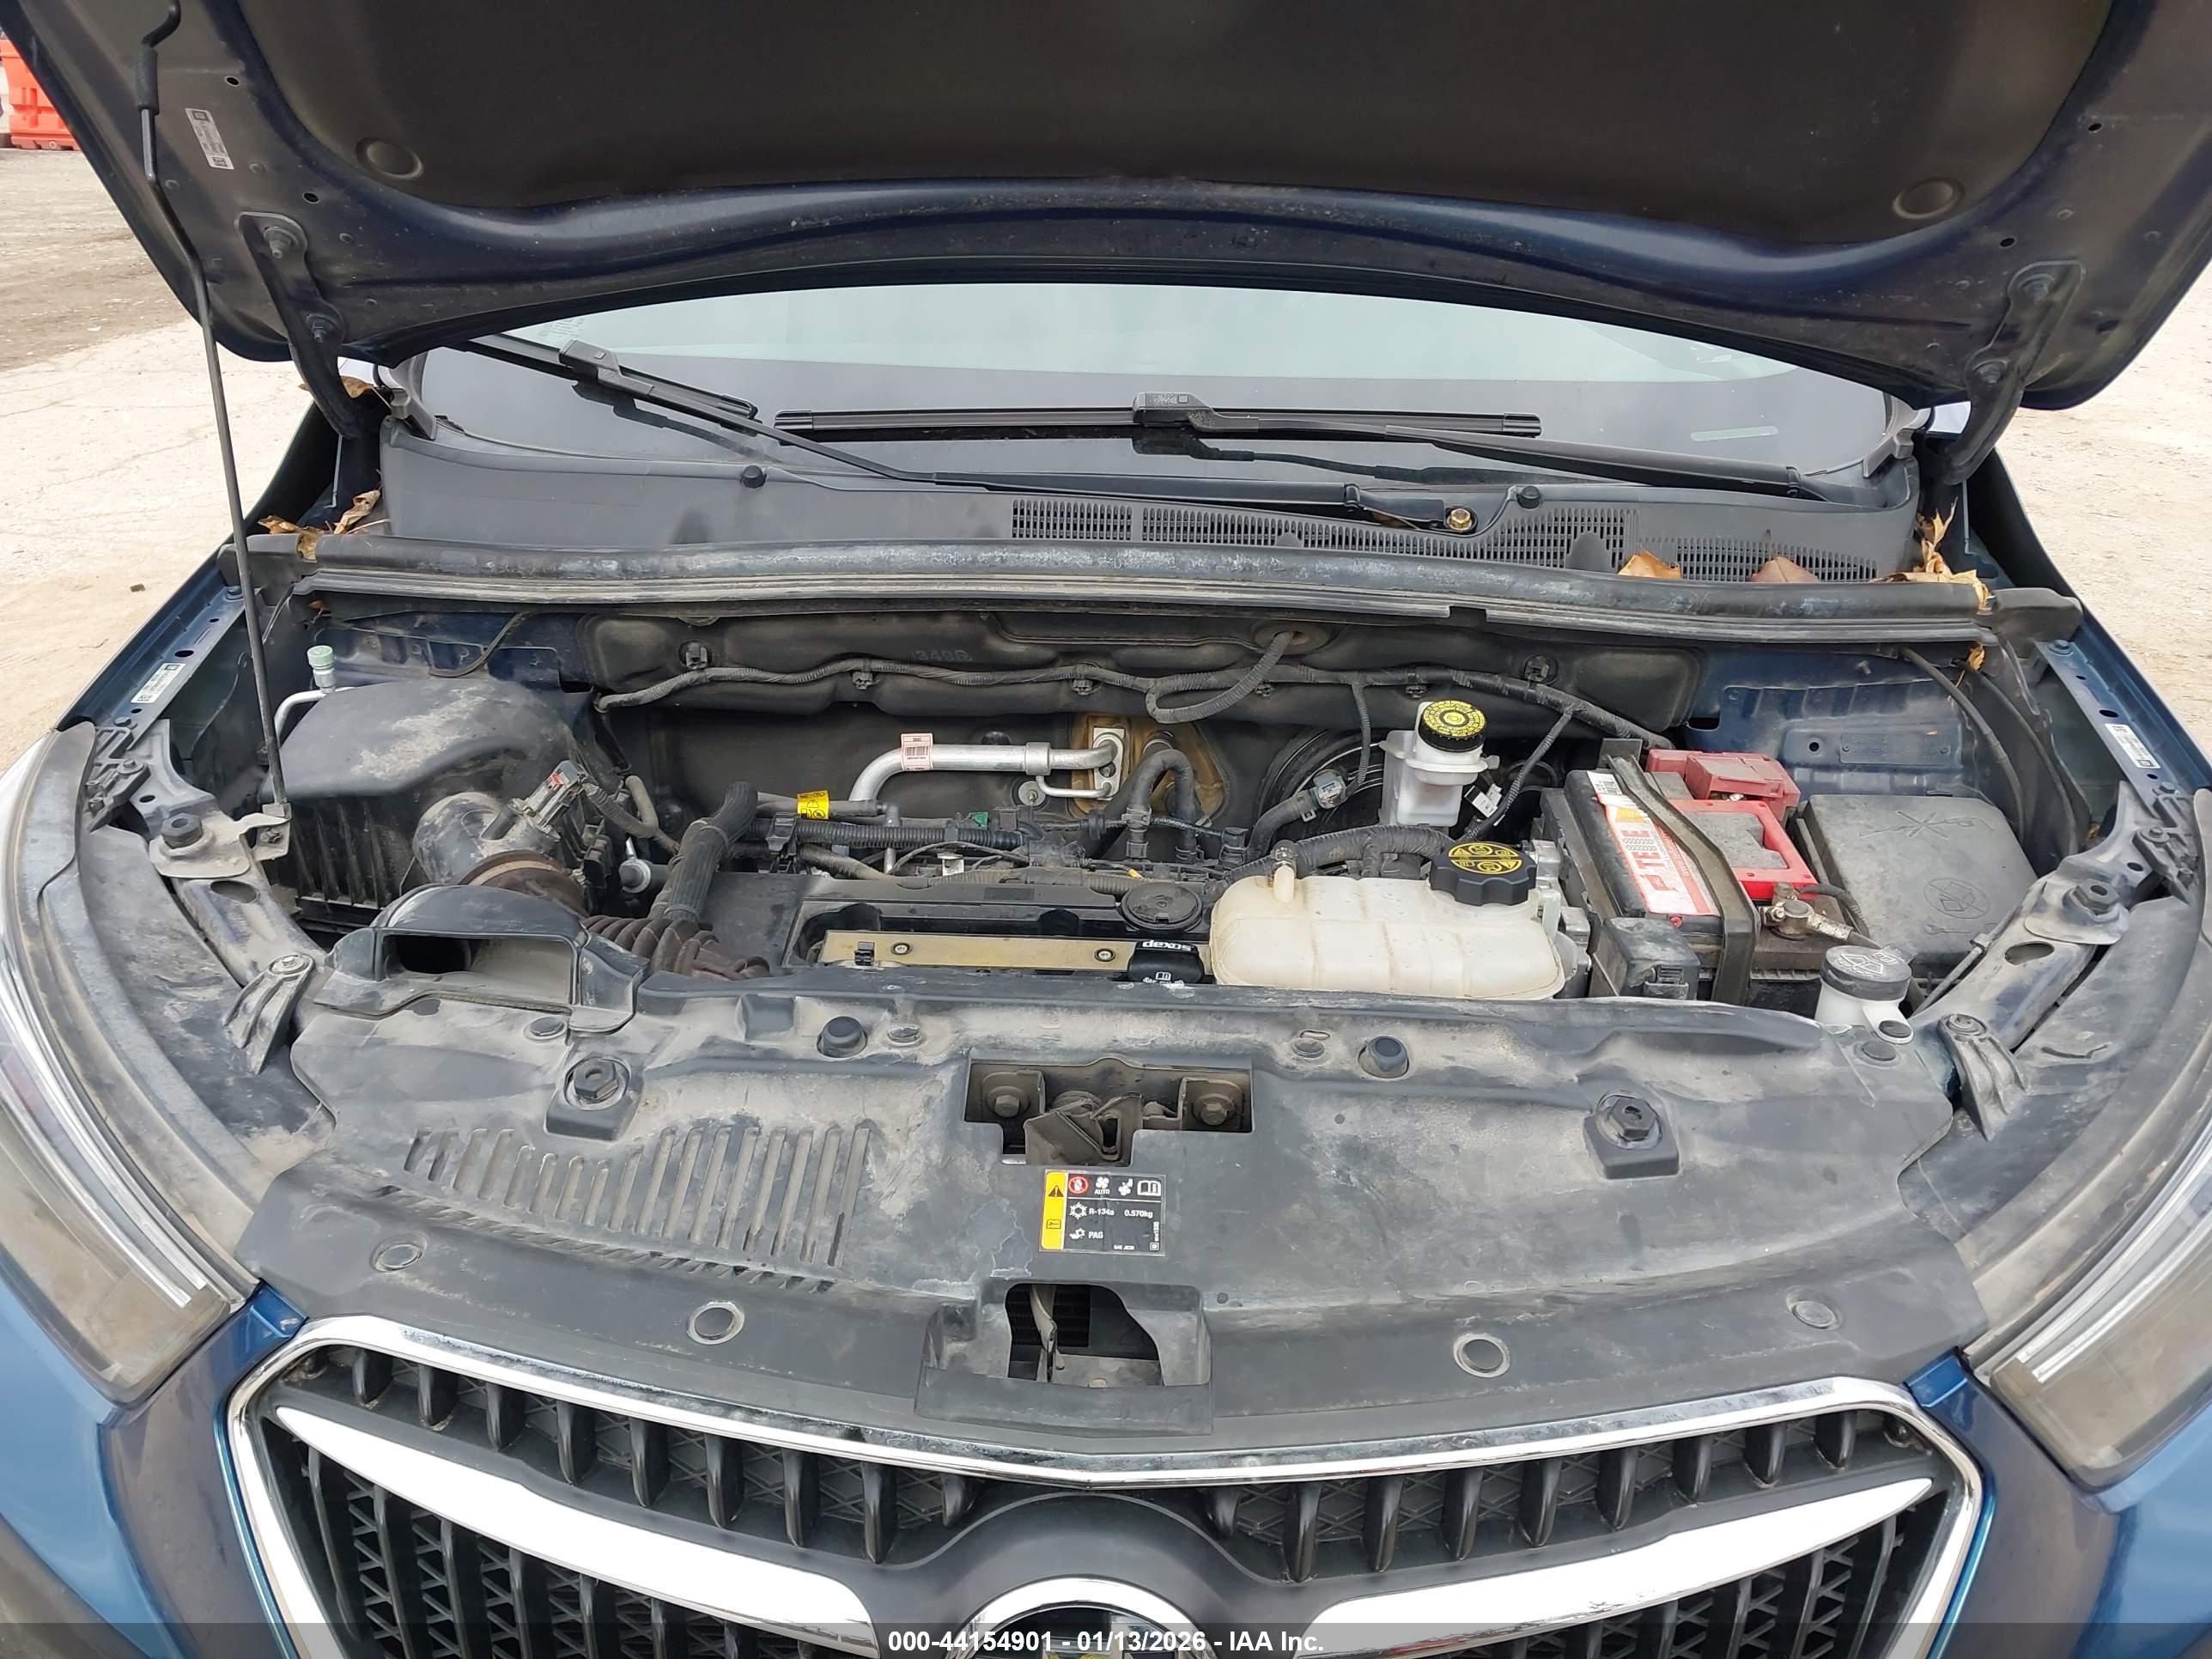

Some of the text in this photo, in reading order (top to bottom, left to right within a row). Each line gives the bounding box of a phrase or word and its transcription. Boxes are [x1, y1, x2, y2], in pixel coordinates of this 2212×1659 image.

[1142, 939, 1191, 951] dexos
[1088, 1207, 1153, 1218] R-134a 0.570kg
[1088, 1231, 1104, 1239] PAG
